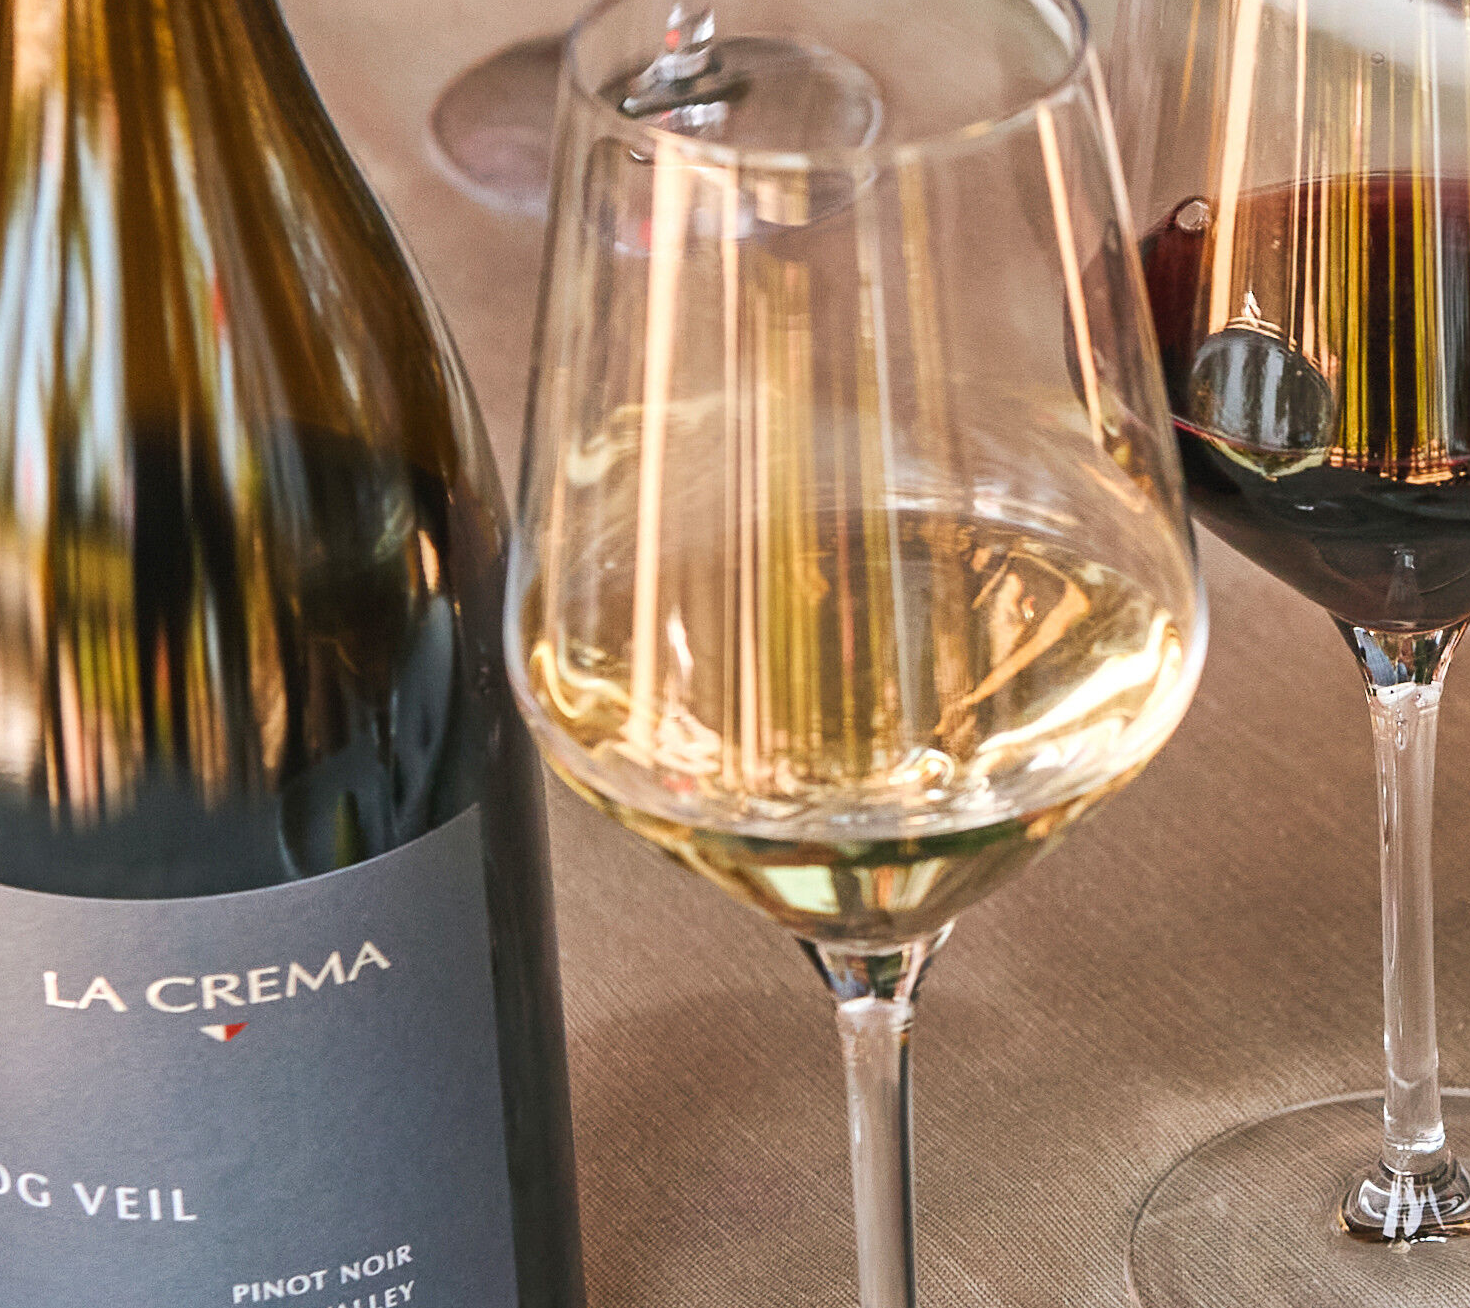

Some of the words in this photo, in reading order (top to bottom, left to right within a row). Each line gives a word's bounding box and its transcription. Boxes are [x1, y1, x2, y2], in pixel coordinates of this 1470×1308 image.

[43, 970, 128, 1013] LA
[145, 939, 391, 1014] CREMA
[72, 1181, 198, 1221] VEIL
[232, 1269, 328, 1304] PINOT
[339, 1244, 413, 1284] NOIR
